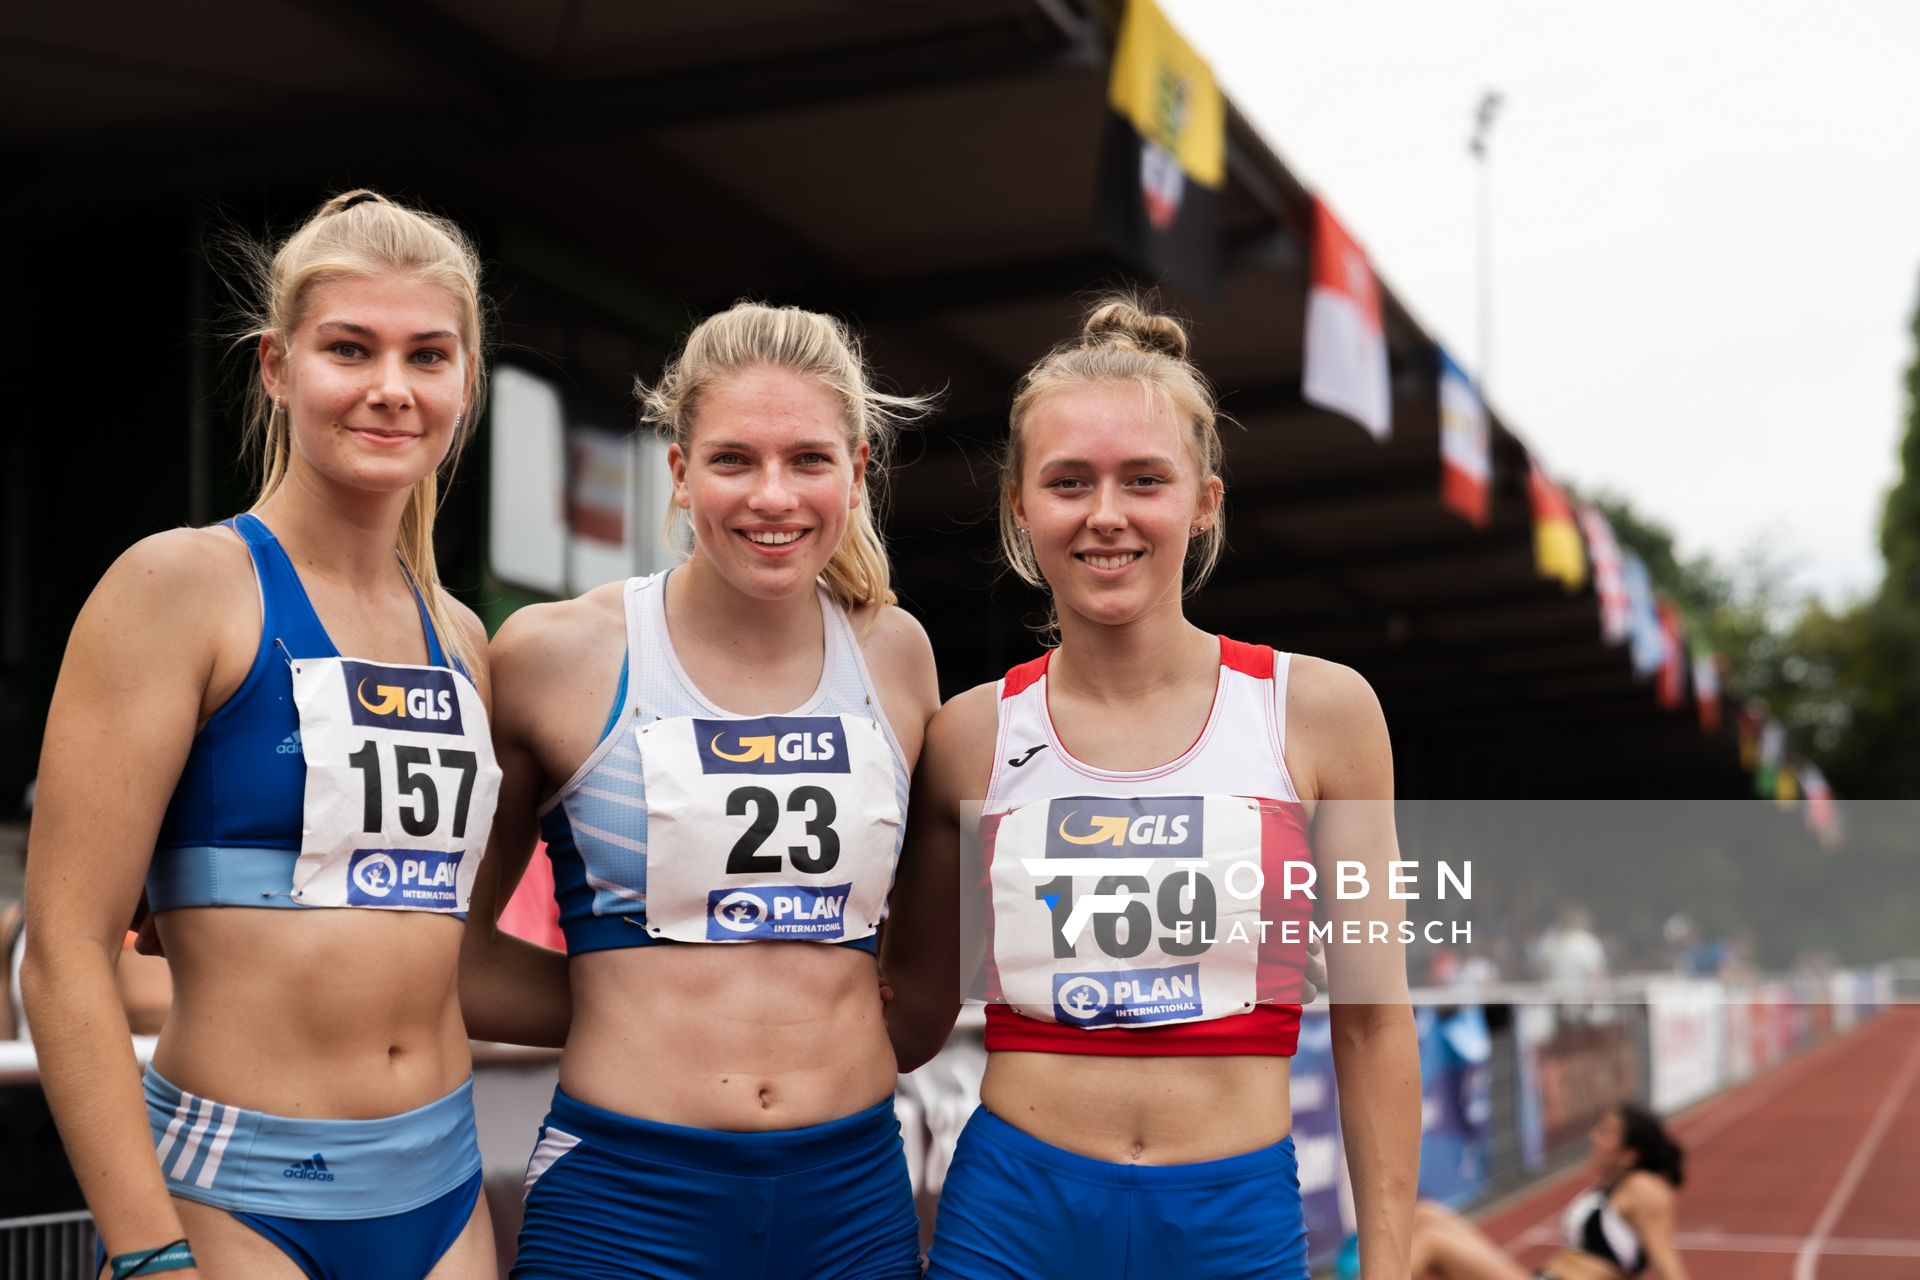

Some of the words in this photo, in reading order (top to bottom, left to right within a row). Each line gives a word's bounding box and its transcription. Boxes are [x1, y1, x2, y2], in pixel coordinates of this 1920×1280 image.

[406, 687, 453, 721] GLS
[276, 742, 303, 754] adi
[777, 732, 835, 762] GLS
[348, 739, 478, 839] 157
[725, 785, 841, 875] 23
[1128, 814, 1190, 845] GLS
[773, 895, 844, 920] PLAN
[1034, 870, 1217, 959] 169
[774, 922, 841, 933] INTERNATIONAL
[1114, 974, 1194, 1006] PLAN
[1115, 1001, 1196, 1018] INTERNATIONAL
[283, 1168, 335, 1182] adidas
